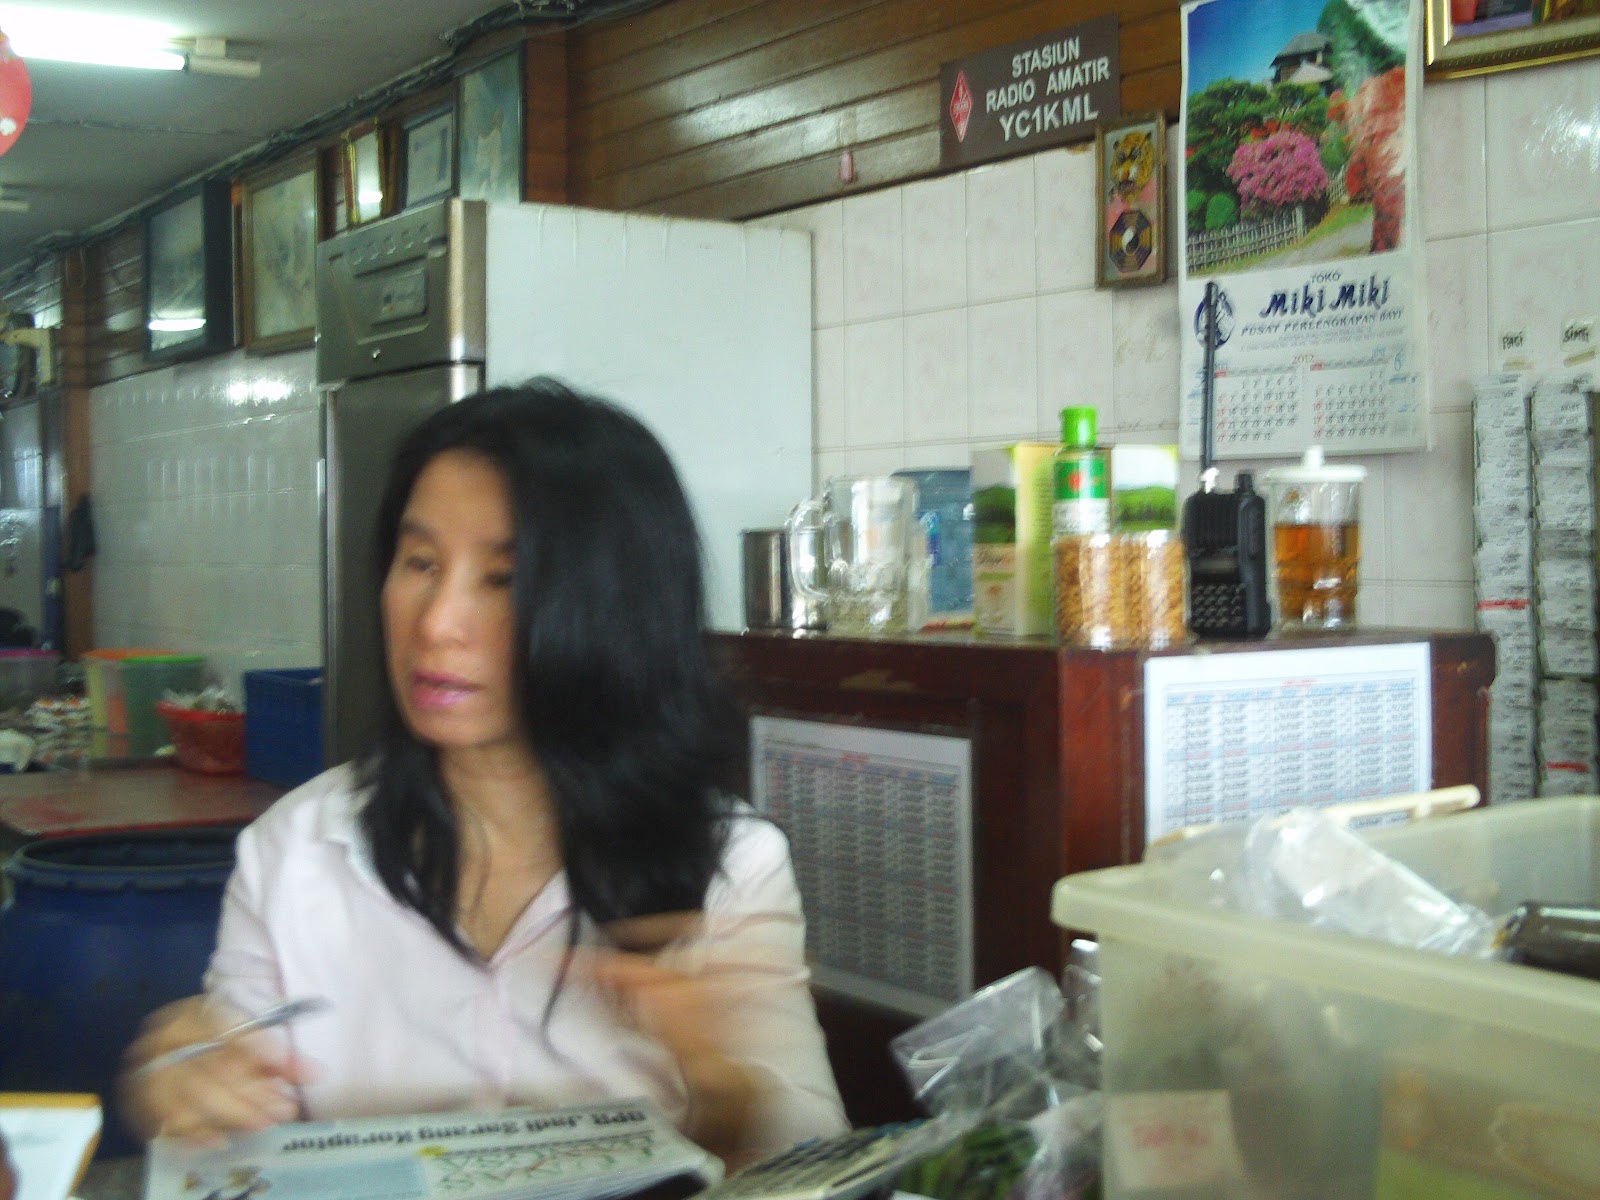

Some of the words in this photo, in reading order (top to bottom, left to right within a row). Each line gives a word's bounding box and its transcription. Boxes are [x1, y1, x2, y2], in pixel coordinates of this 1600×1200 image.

[1012, 36, 1080, 78] STASIUN
[986, 78, 1036, 113] RADIO
[1046, 56, 1110, 97] AMATIR
[999, 93, 1099, 142] YC1KML
[1259, 282, 1326, 318] Miki
[1329, 273, 1390, 310] Miki
[1311, 270, 1342, 284] TOKO
[1241, 322, 1281, 337] PUSAT
[1283, 312, 1376, 333] PERLENGKAPAN
[1379, 309, 1404, 323] BAYI
